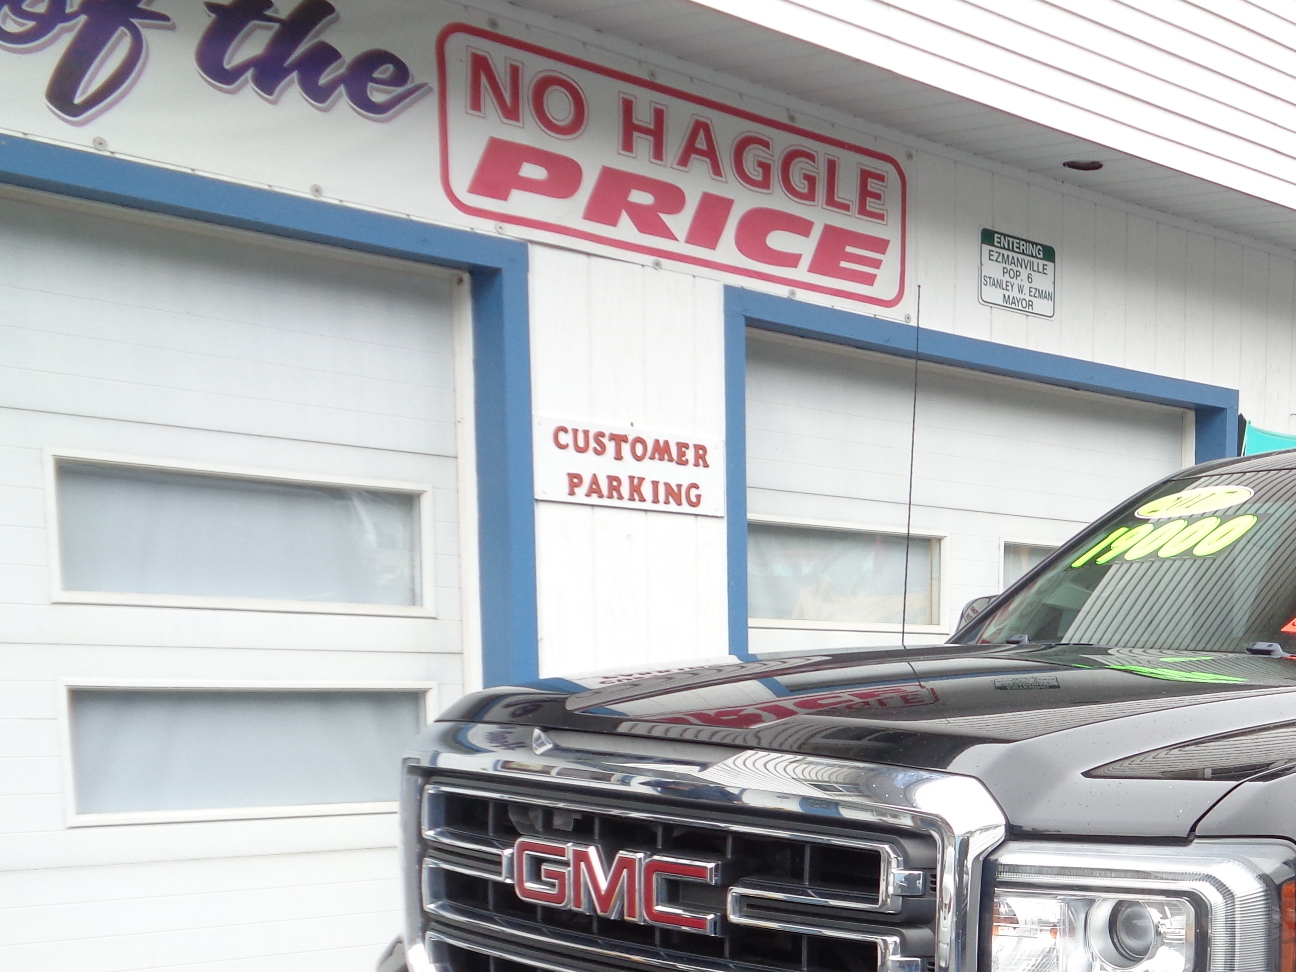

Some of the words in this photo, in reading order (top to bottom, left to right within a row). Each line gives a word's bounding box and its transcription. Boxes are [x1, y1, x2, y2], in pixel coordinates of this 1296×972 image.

[195, 0, 432, 120] the
[466, 46, 588, 140] NO
[617, 91, 888, 226] HAGGLE
[467, 136, 890, 287] PRICE
[988, 249, 1048, 275] EZMANVILLE
[994, 234, 1043, 258] ENTERING
[983, 275, 1015, 292] STANLEY
[1017, 283, 1026, 295] W.
[1029, 287, 1053, 302] EZMAN
[1002, 267, 1023, 282] POP.
[1027, 273, 1033, 284] 6
[1003, 294, 1034, 311] MAYOR
[553, 425, 710, 468] CUSTOMER
[566, 472, 702, 508] PARKING
[514, 835, 720, 937] GMC
